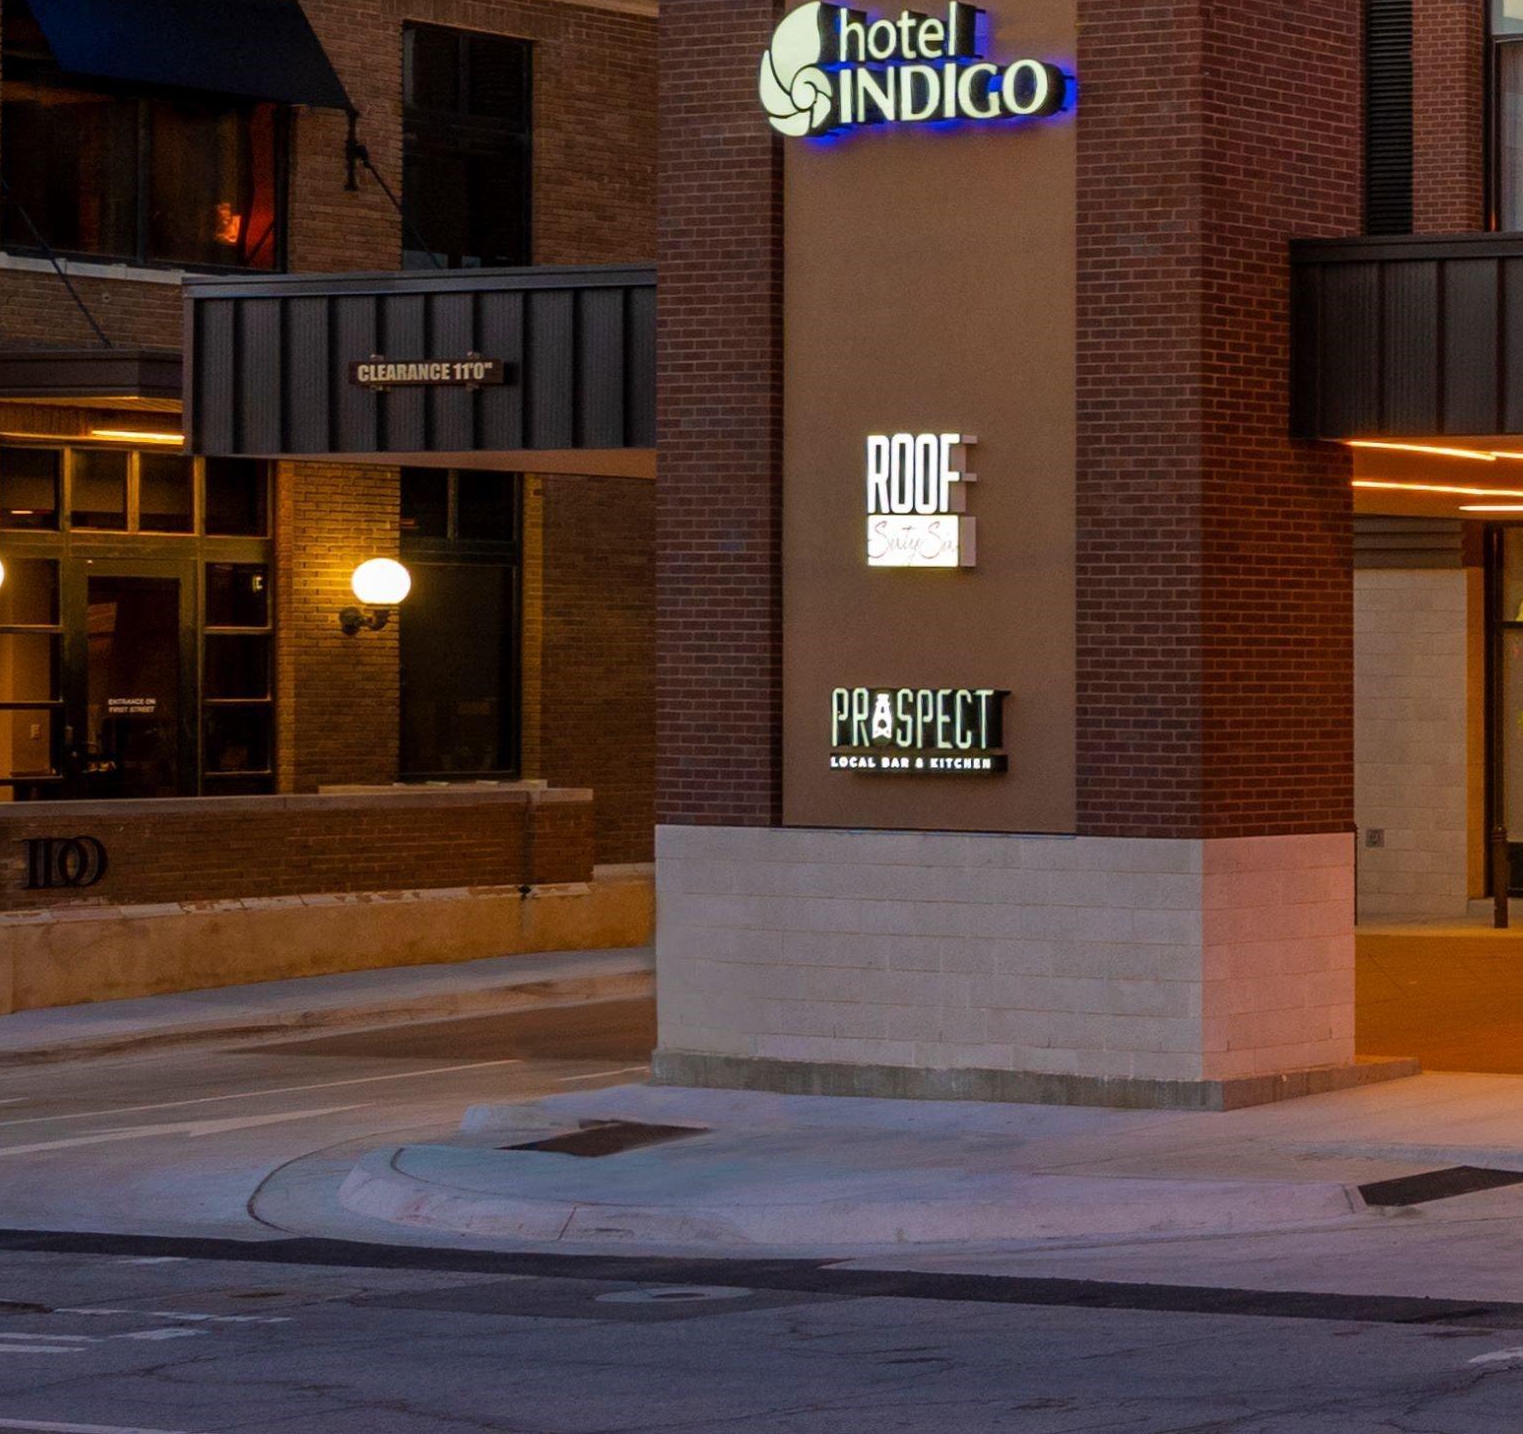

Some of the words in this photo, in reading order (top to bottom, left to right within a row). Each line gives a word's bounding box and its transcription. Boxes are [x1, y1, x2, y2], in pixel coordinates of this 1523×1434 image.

[840, 1, 957, 62] hotel
[840, 59, 1048, 123] INDIGO
[357, 363, 450, 382] CLEARANCE
[453, 362, 493, 380] 11'0"
[867, 433, 960, 515] ROOF
[830, 756, 876, 768] LOCAL
[881, 756, 909, 768] BAR
[915, 757, 924, 768] &
[930, 757, 991, 769] KITCHEN
